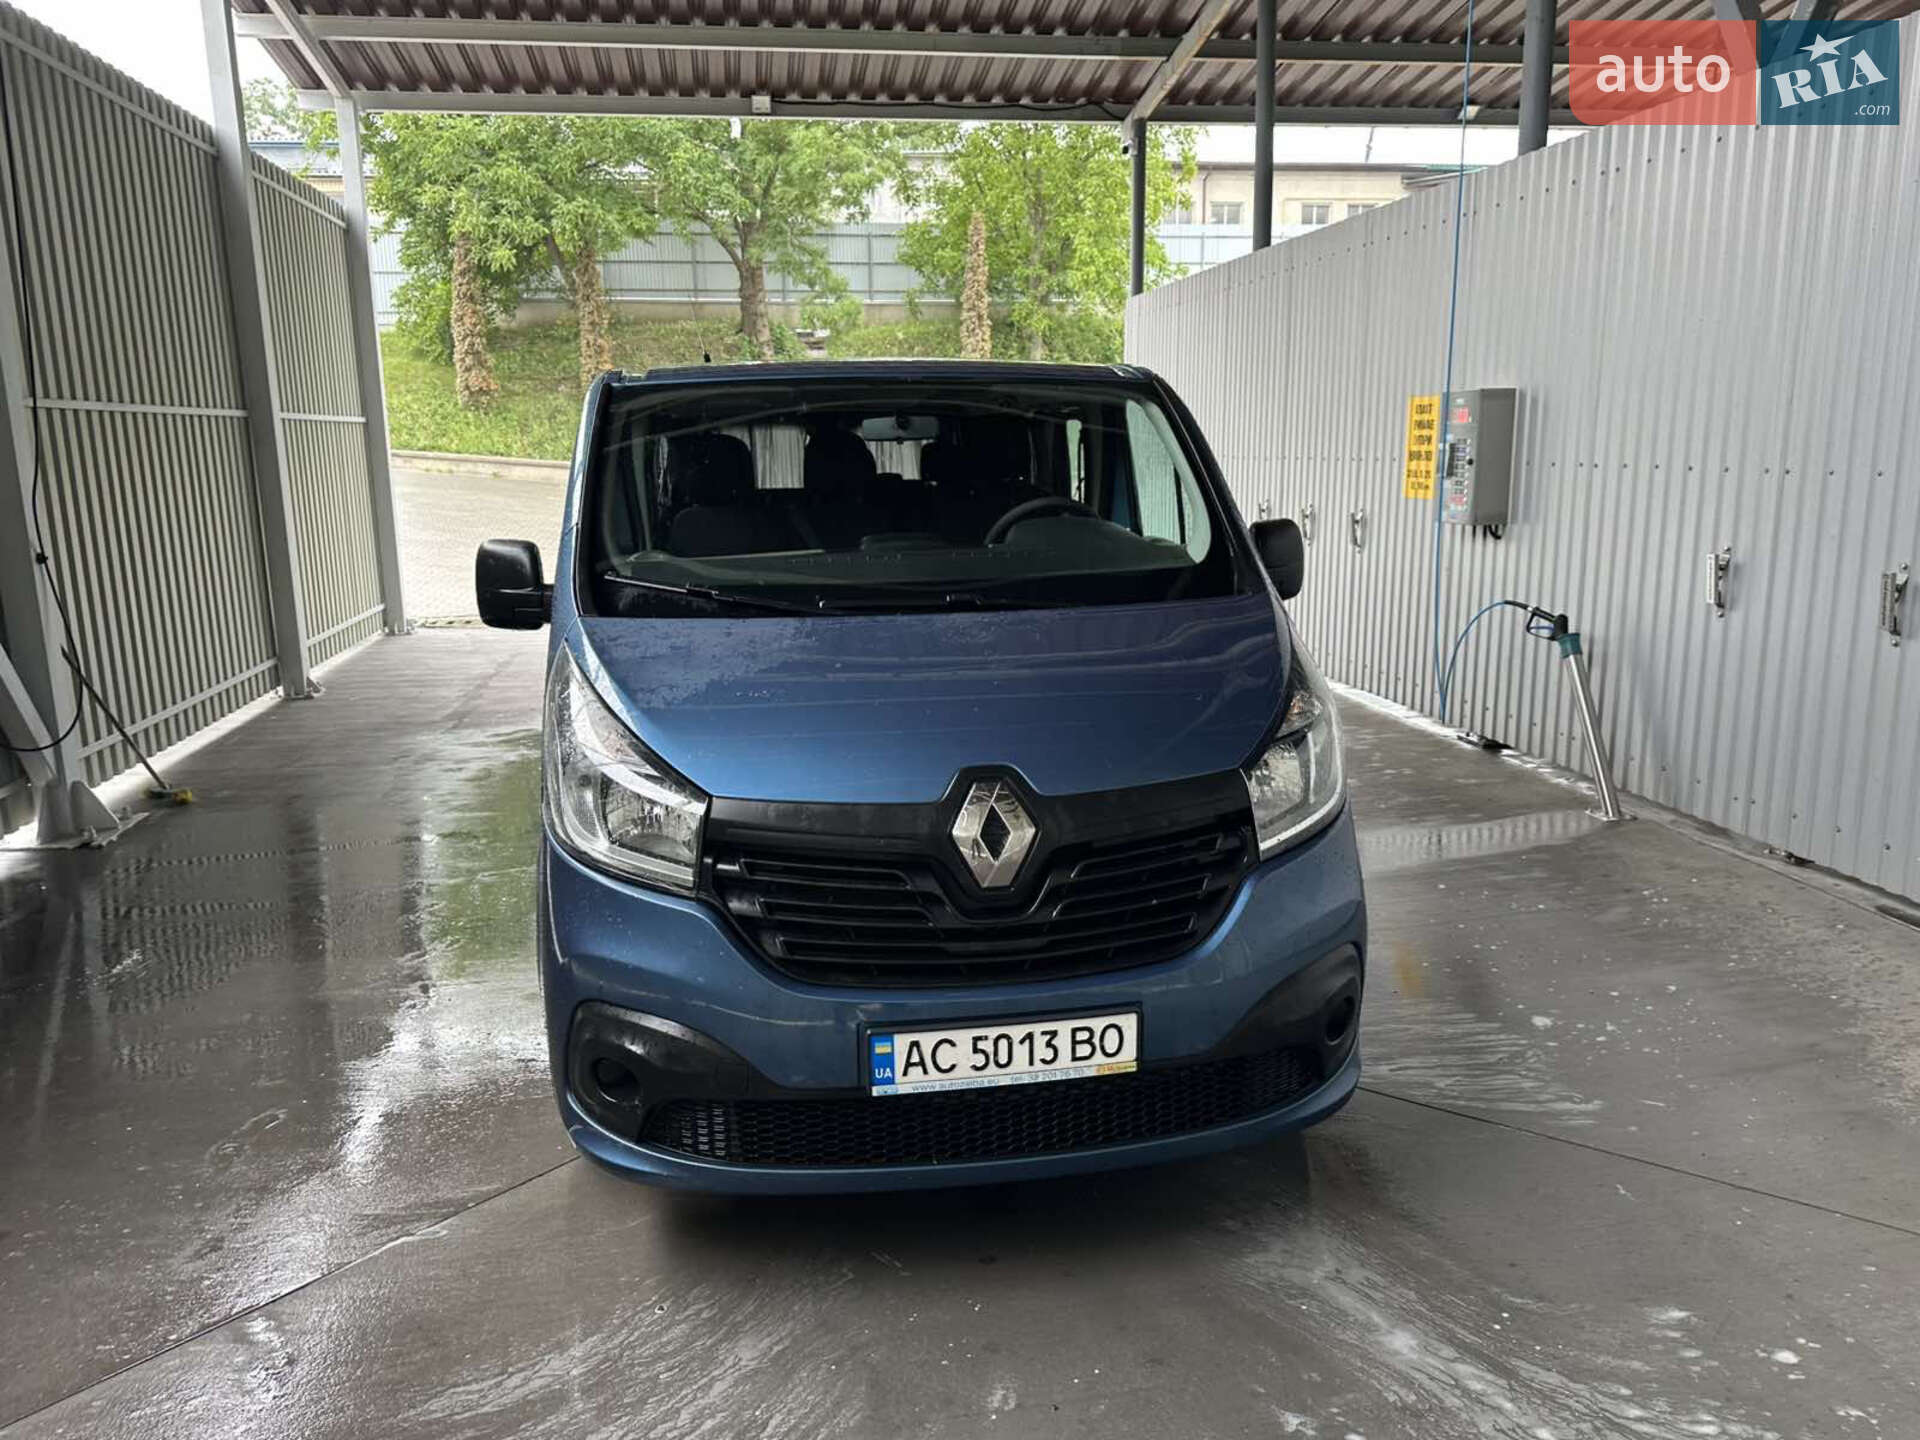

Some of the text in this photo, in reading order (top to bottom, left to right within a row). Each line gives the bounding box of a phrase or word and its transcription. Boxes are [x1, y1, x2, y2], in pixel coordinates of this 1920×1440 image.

[902, 1022, 1125, 1077] AC 5013 BO
[875, 1069, 892, 1080] UA
